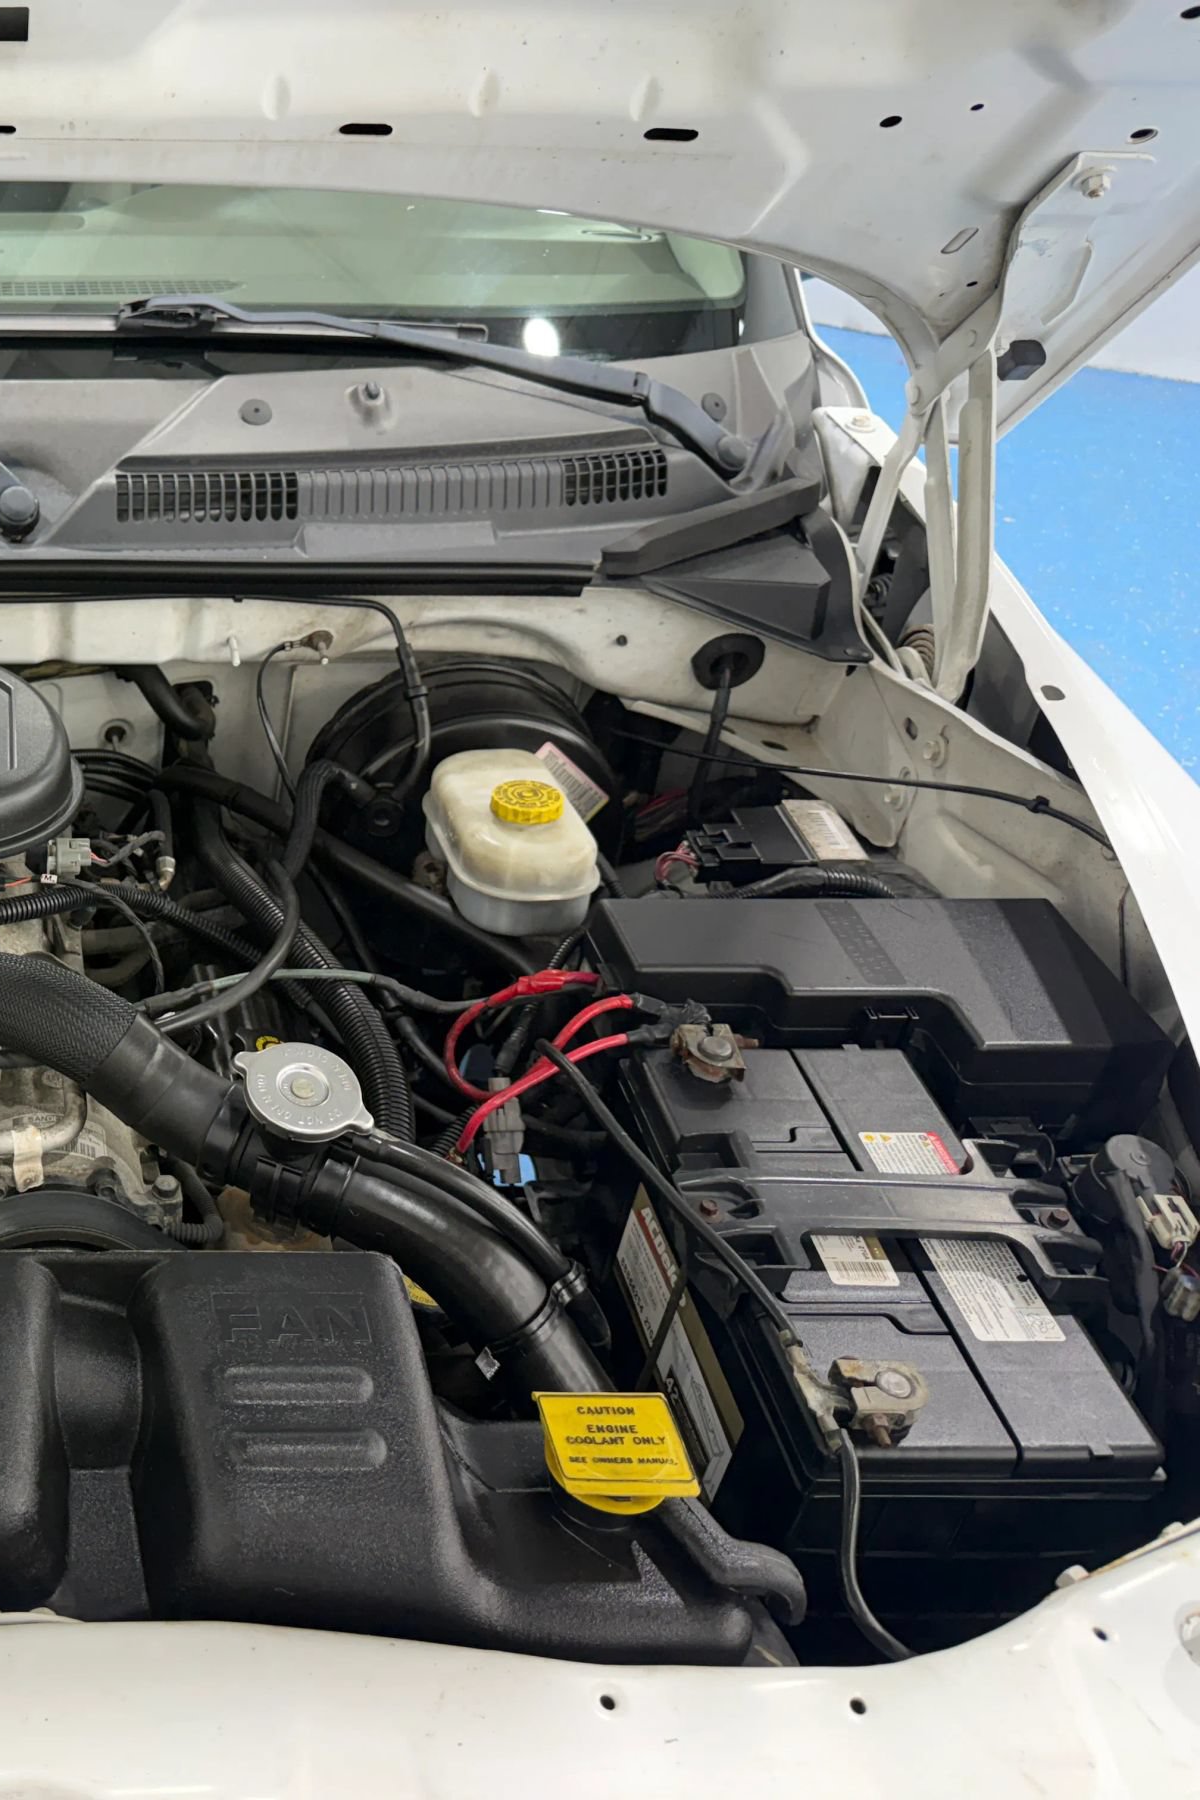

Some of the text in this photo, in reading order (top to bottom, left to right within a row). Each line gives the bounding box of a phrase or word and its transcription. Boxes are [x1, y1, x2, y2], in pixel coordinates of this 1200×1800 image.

[216, 1304, 374, 1343] FAN
[576, 1406, 636, 1416] CAUTION
[587, 1424, 639, 1434] ENGINE
[566, 1436, 666, 1445] COOLANT ONLY
[569, 1456, 588, 1464] SEE
[592, 1456, 634, 1464] OWNERS
